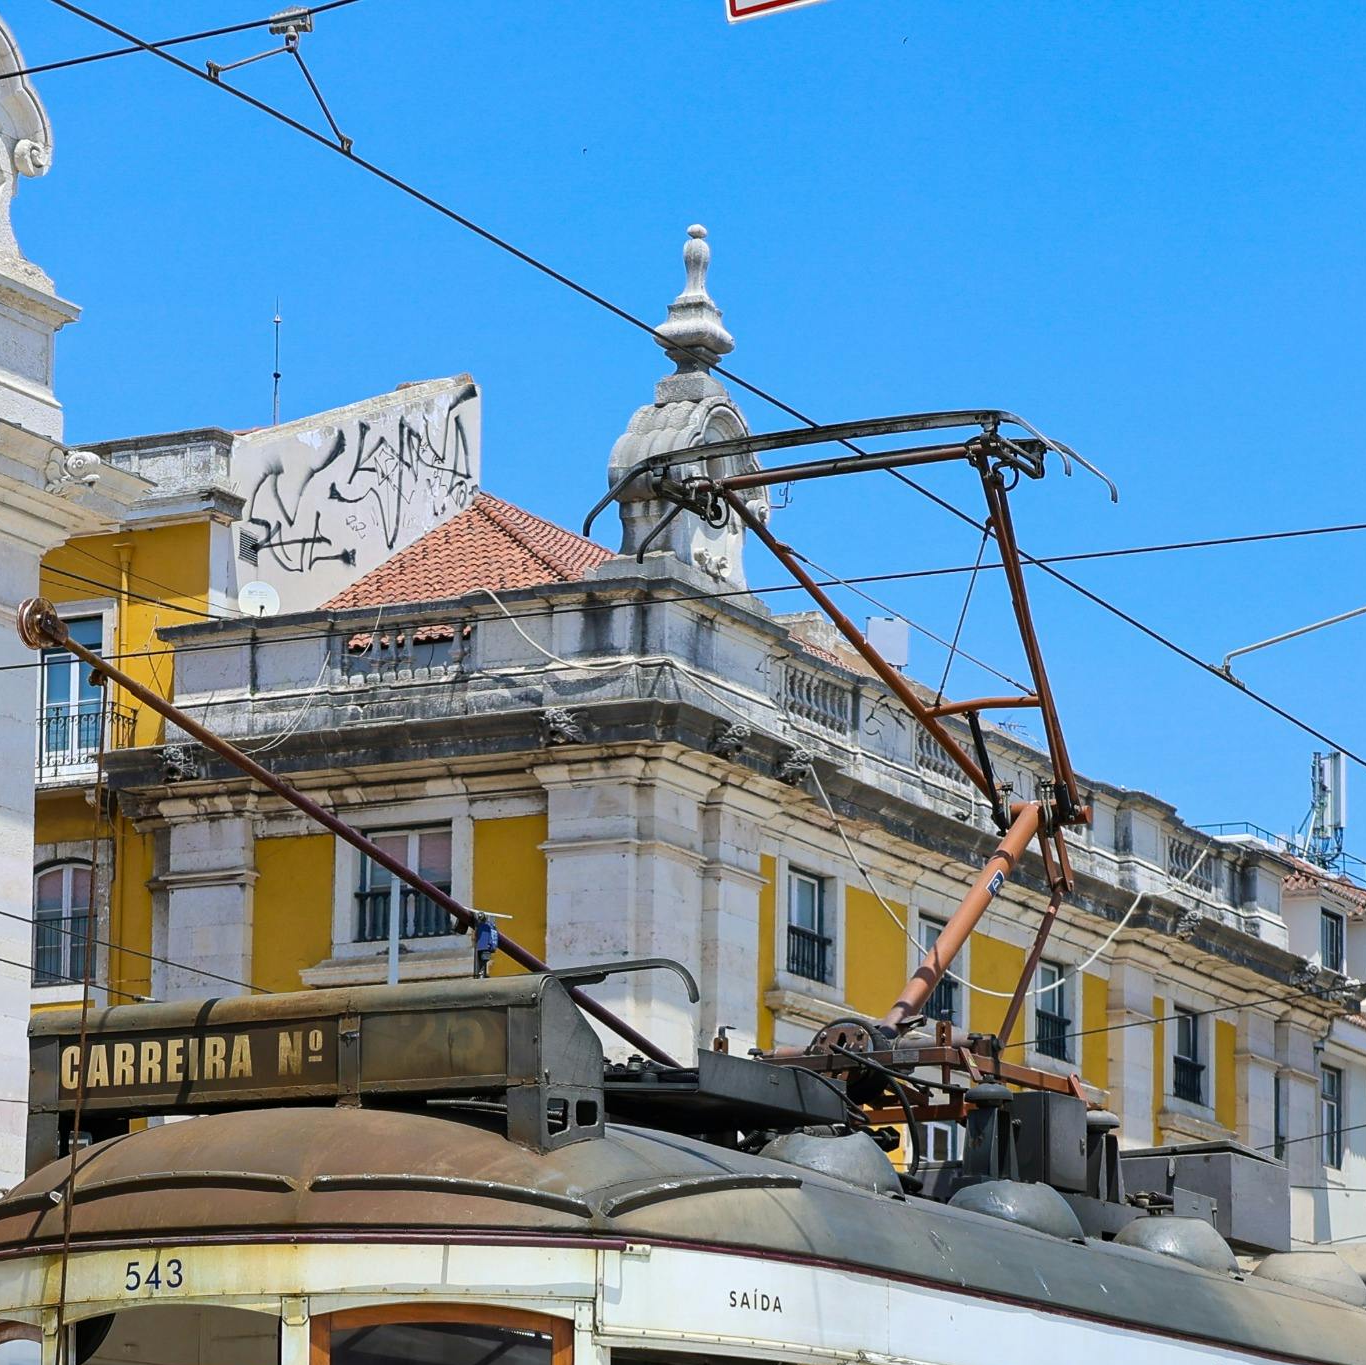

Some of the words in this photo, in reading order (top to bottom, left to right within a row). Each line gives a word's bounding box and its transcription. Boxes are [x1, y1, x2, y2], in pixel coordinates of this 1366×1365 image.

[61, 1035, 253, 1089] CARREIRA
[278, 1029, 323, 1076] Nº
[125, 1259, 183, 1291] 543
[729, 1288, 782, 1313] SAÍDA
